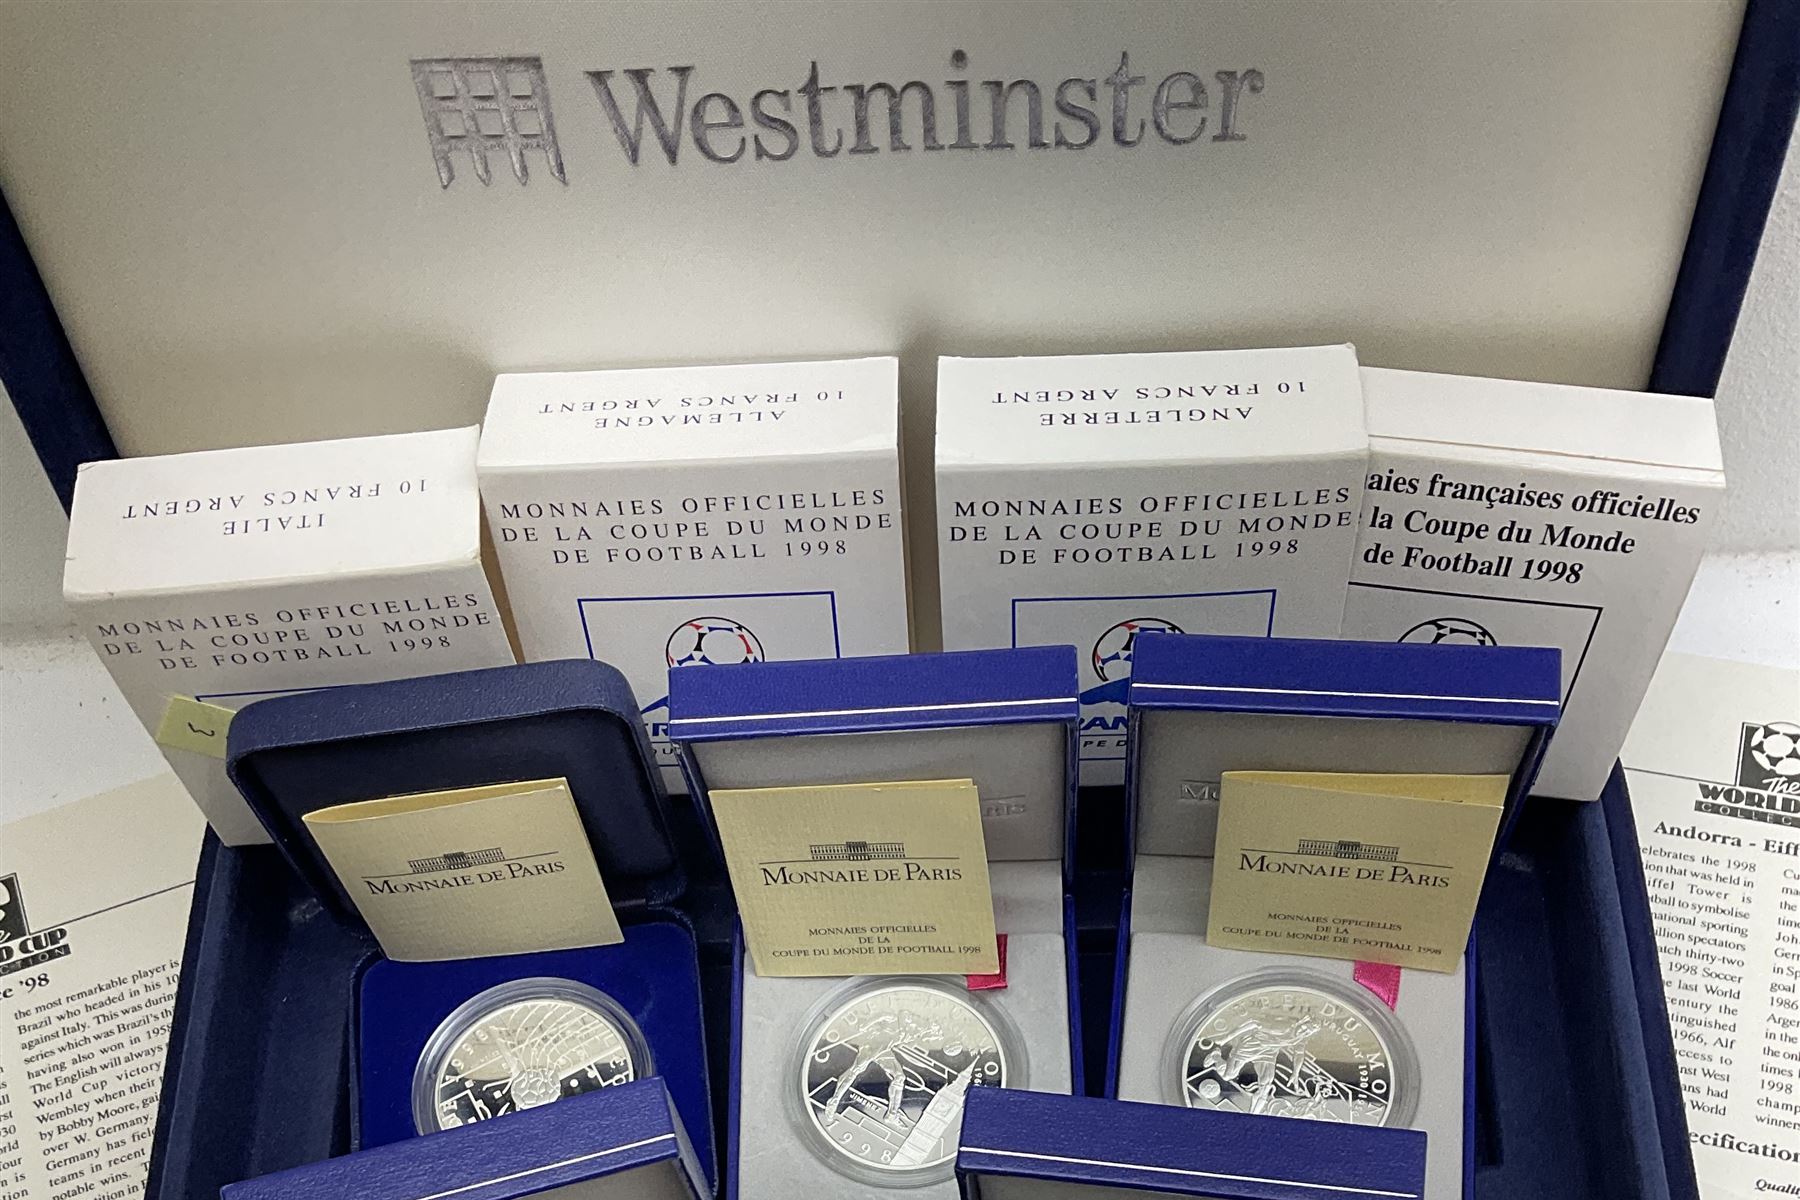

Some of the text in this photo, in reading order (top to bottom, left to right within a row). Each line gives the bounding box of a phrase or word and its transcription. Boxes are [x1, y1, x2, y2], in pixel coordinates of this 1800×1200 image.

[584, 49, 1264, 167] Westminster
[539, 391, 843, 414] 10 FRANCS ARGENT
[993, 382, 1304, 404] 10 FRANCS ARGENT
[594, 410, 785, 428] ALLEMAGNE
[1040, 407, 1252, 426] ANGLETERRE
[123, 479, 426, 519] 10 FRANCS ARGENT
[502, 490, 885, 519] MONNAIES OFFICIELLES
[955, 488, 1350, 517] MONNAIES OFFICIELLES
[1364, 469, 1700, 524] aies françaises officielles
[223, 514, 325, 535] ITALIE
[502, 514, 891, 542] DE LA COUPE DU MONDE
[950, 511, 1351, 542] DE LA COUPE DU MONDE
[1369, 507, 1636, 554] la Coupe du Monde
[553, 540, 847, 564] DE FOOTBALL 1998
[999, 539, 1299, 565] DE FOOTBALL 1998
[1363, 543, 1583, 584] de Football 1998
[99, 593, 478, 637] MONNAIES OFFICIELLES
[104, 613, 490, 655] DE LA COUPE DU MONDE
[161, 636, 451, 670] DE FOOTBALL 1998
[1653, 821, 1742, 847] Andorra
[760, 862, 962, 886] MONNAIE DE PARIS
[1239, 854, 1449, 889] MONNAIE DE PARIS
[1702, 852, 1757, 873] the 1998
[364, 860, 564, 895] MONNAIE DE PARIS
[1688, 883, 1752, 904] Tower is
[1268, 912, 1402, 932] MONNAIES OFFICIELLES
[1691, 902, 1750, 919] symbolise
[19, 928, 67, 954] CUP
[808, 924, 936, 936] MONNAIES OFFICIELLES
[858, 936, 890, 944] DE LA
[1222, 926, 1442, 956] COUPE DU MONDE DE FOOTBALL 1998
[1316, 925, 1349, 935] DE LA
[1701, 919, 1749, 938] sporting
[772, 945, 981, 957] COUPE DU MONDE DE FOOTBALL 1998
[1669, 961, 1744, 984] 1998 Soccer
[14, 959, 180, 1020] the most remarkable player is
[49, 1149, 146, 1187] teams in recent
